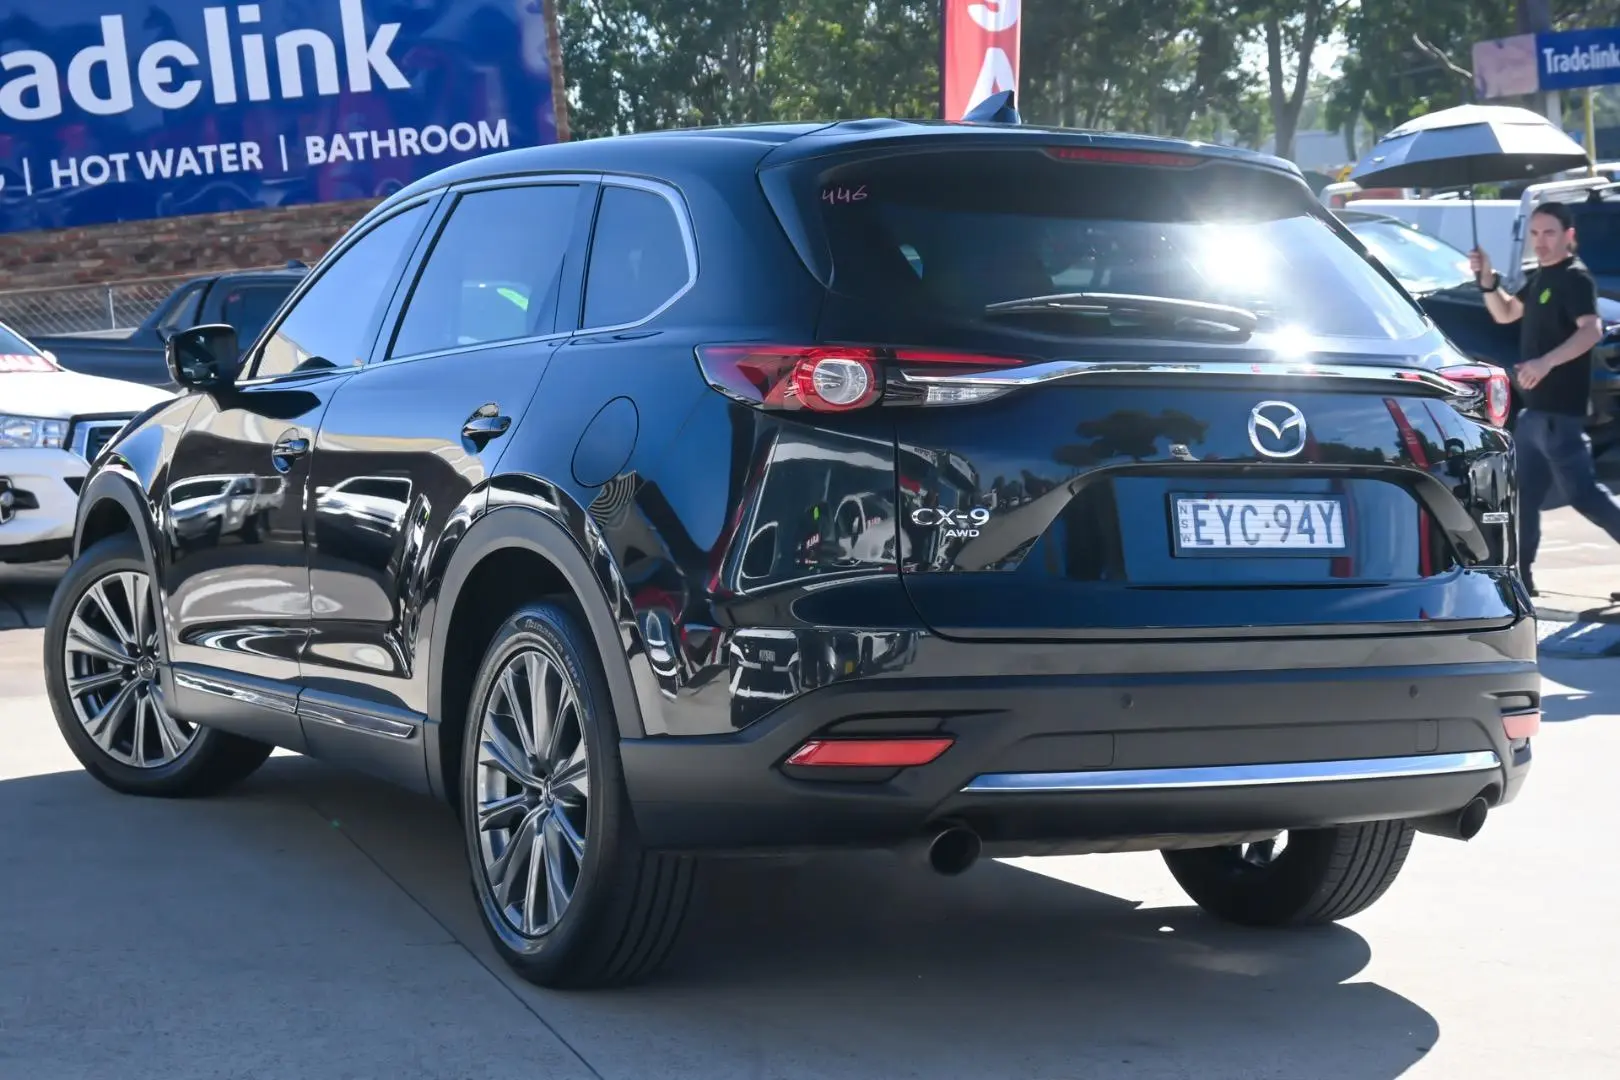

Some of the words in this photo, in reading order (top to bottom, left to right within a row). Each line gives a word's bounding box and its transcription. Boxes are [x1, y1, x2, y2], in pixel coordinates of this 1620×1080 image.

[1542, 43, 1620, 74] Tradelink
[50, 152, 130, 189] HOT
[136, 141, 263, 181] WATER
[305, 119, 510, 166] BATHROOM
[822, 184, 868, 205] 446
[911, 507, 990, 526] CX-9
[945, 529, 980, 537] AWD
